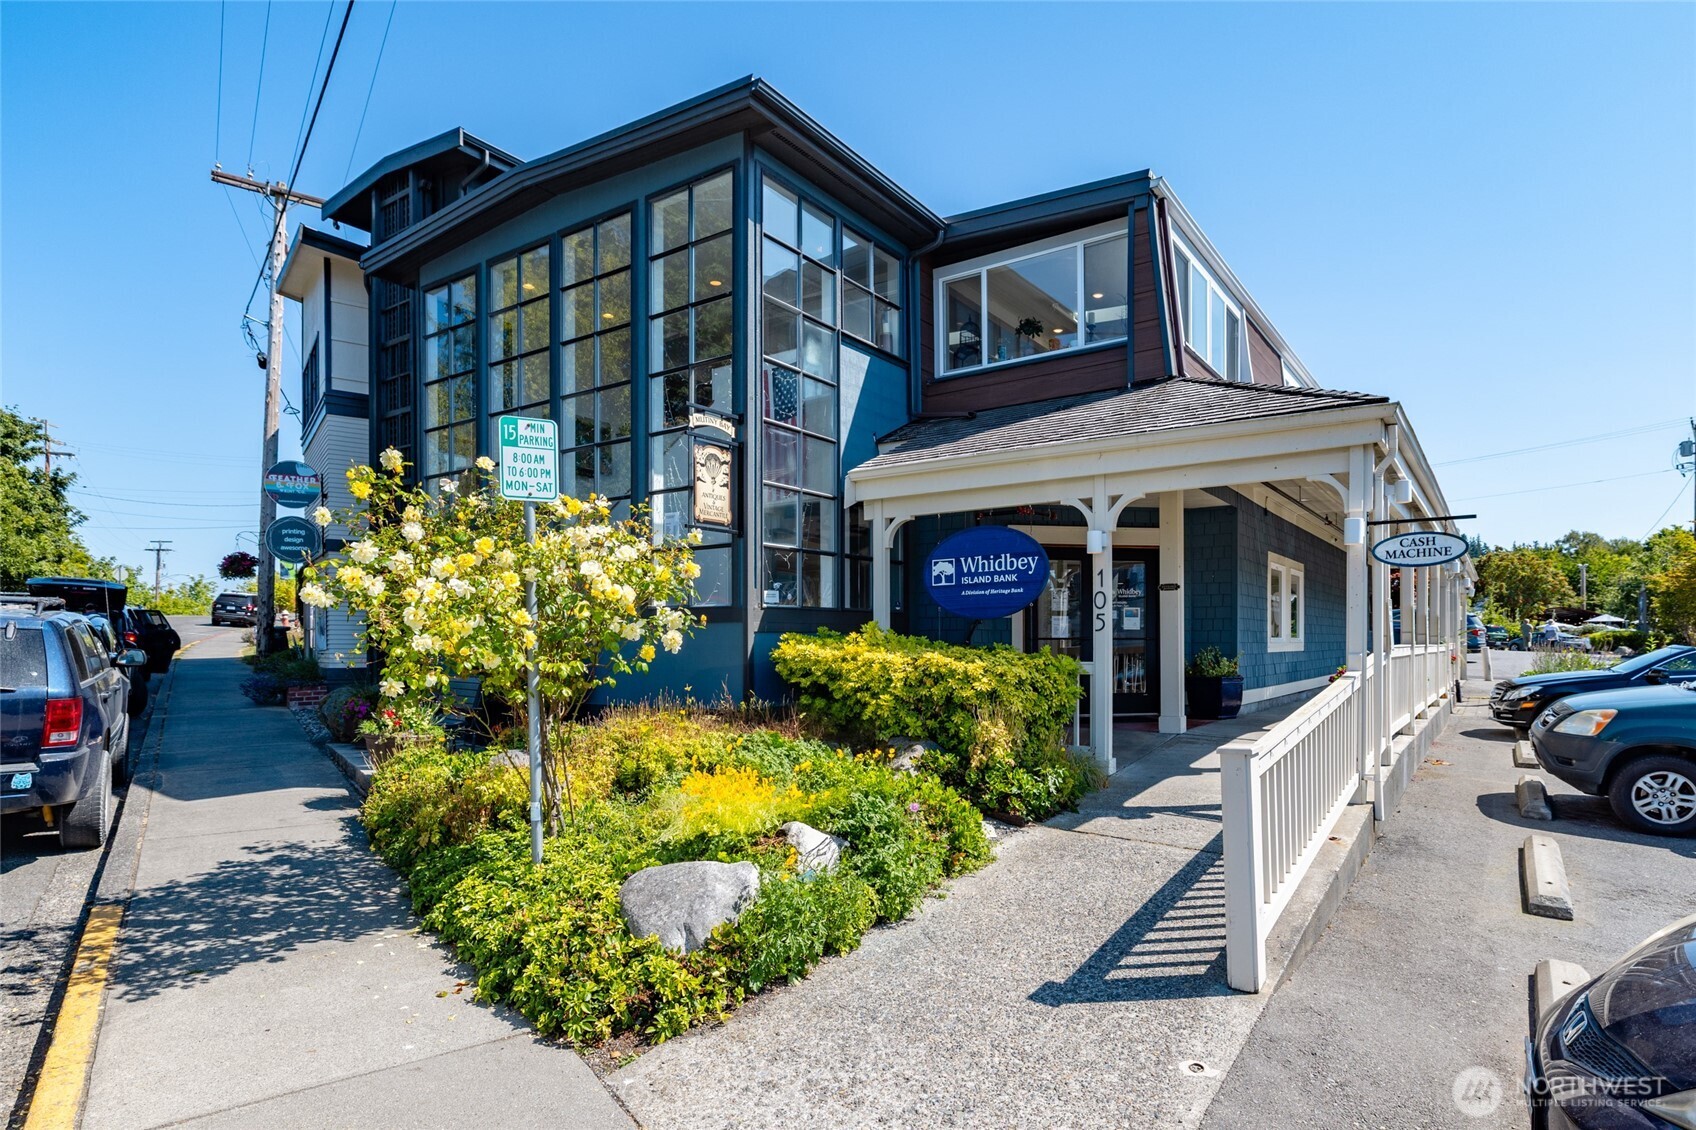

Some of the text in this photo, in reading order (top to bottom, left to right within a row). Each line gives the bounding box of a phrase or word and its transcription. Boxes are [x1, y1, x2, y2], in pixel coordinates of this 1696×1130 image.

[530, 423, 545, 433] MIN
[695, 416, 731, 430] MUTINY BAY
[503, 424, 517, 440] 15
[519, 434, 553, 447] PARKING
[513, 452, 545, 465] 8:00 AM
[507, 466, 551, 478] TO 6:00 PM
[268, 474, 316, 484] FEATHER
[286, 481, 309, 490] FOX
[702, 492, 726, 501] ANTIQUES
[703, 502, 724, 512] VINTAGE
[1399, 536, 1436, 548] CASH
[1385, 546, 1452, 560] MACHINE
[960, 553, 1038, 574] Whidbey
[961, 574, 1018, 584] ISLAND BANK
[1117, 587, 1141, 596] Whidbey
[1093, 568, 1107, 632] 105
